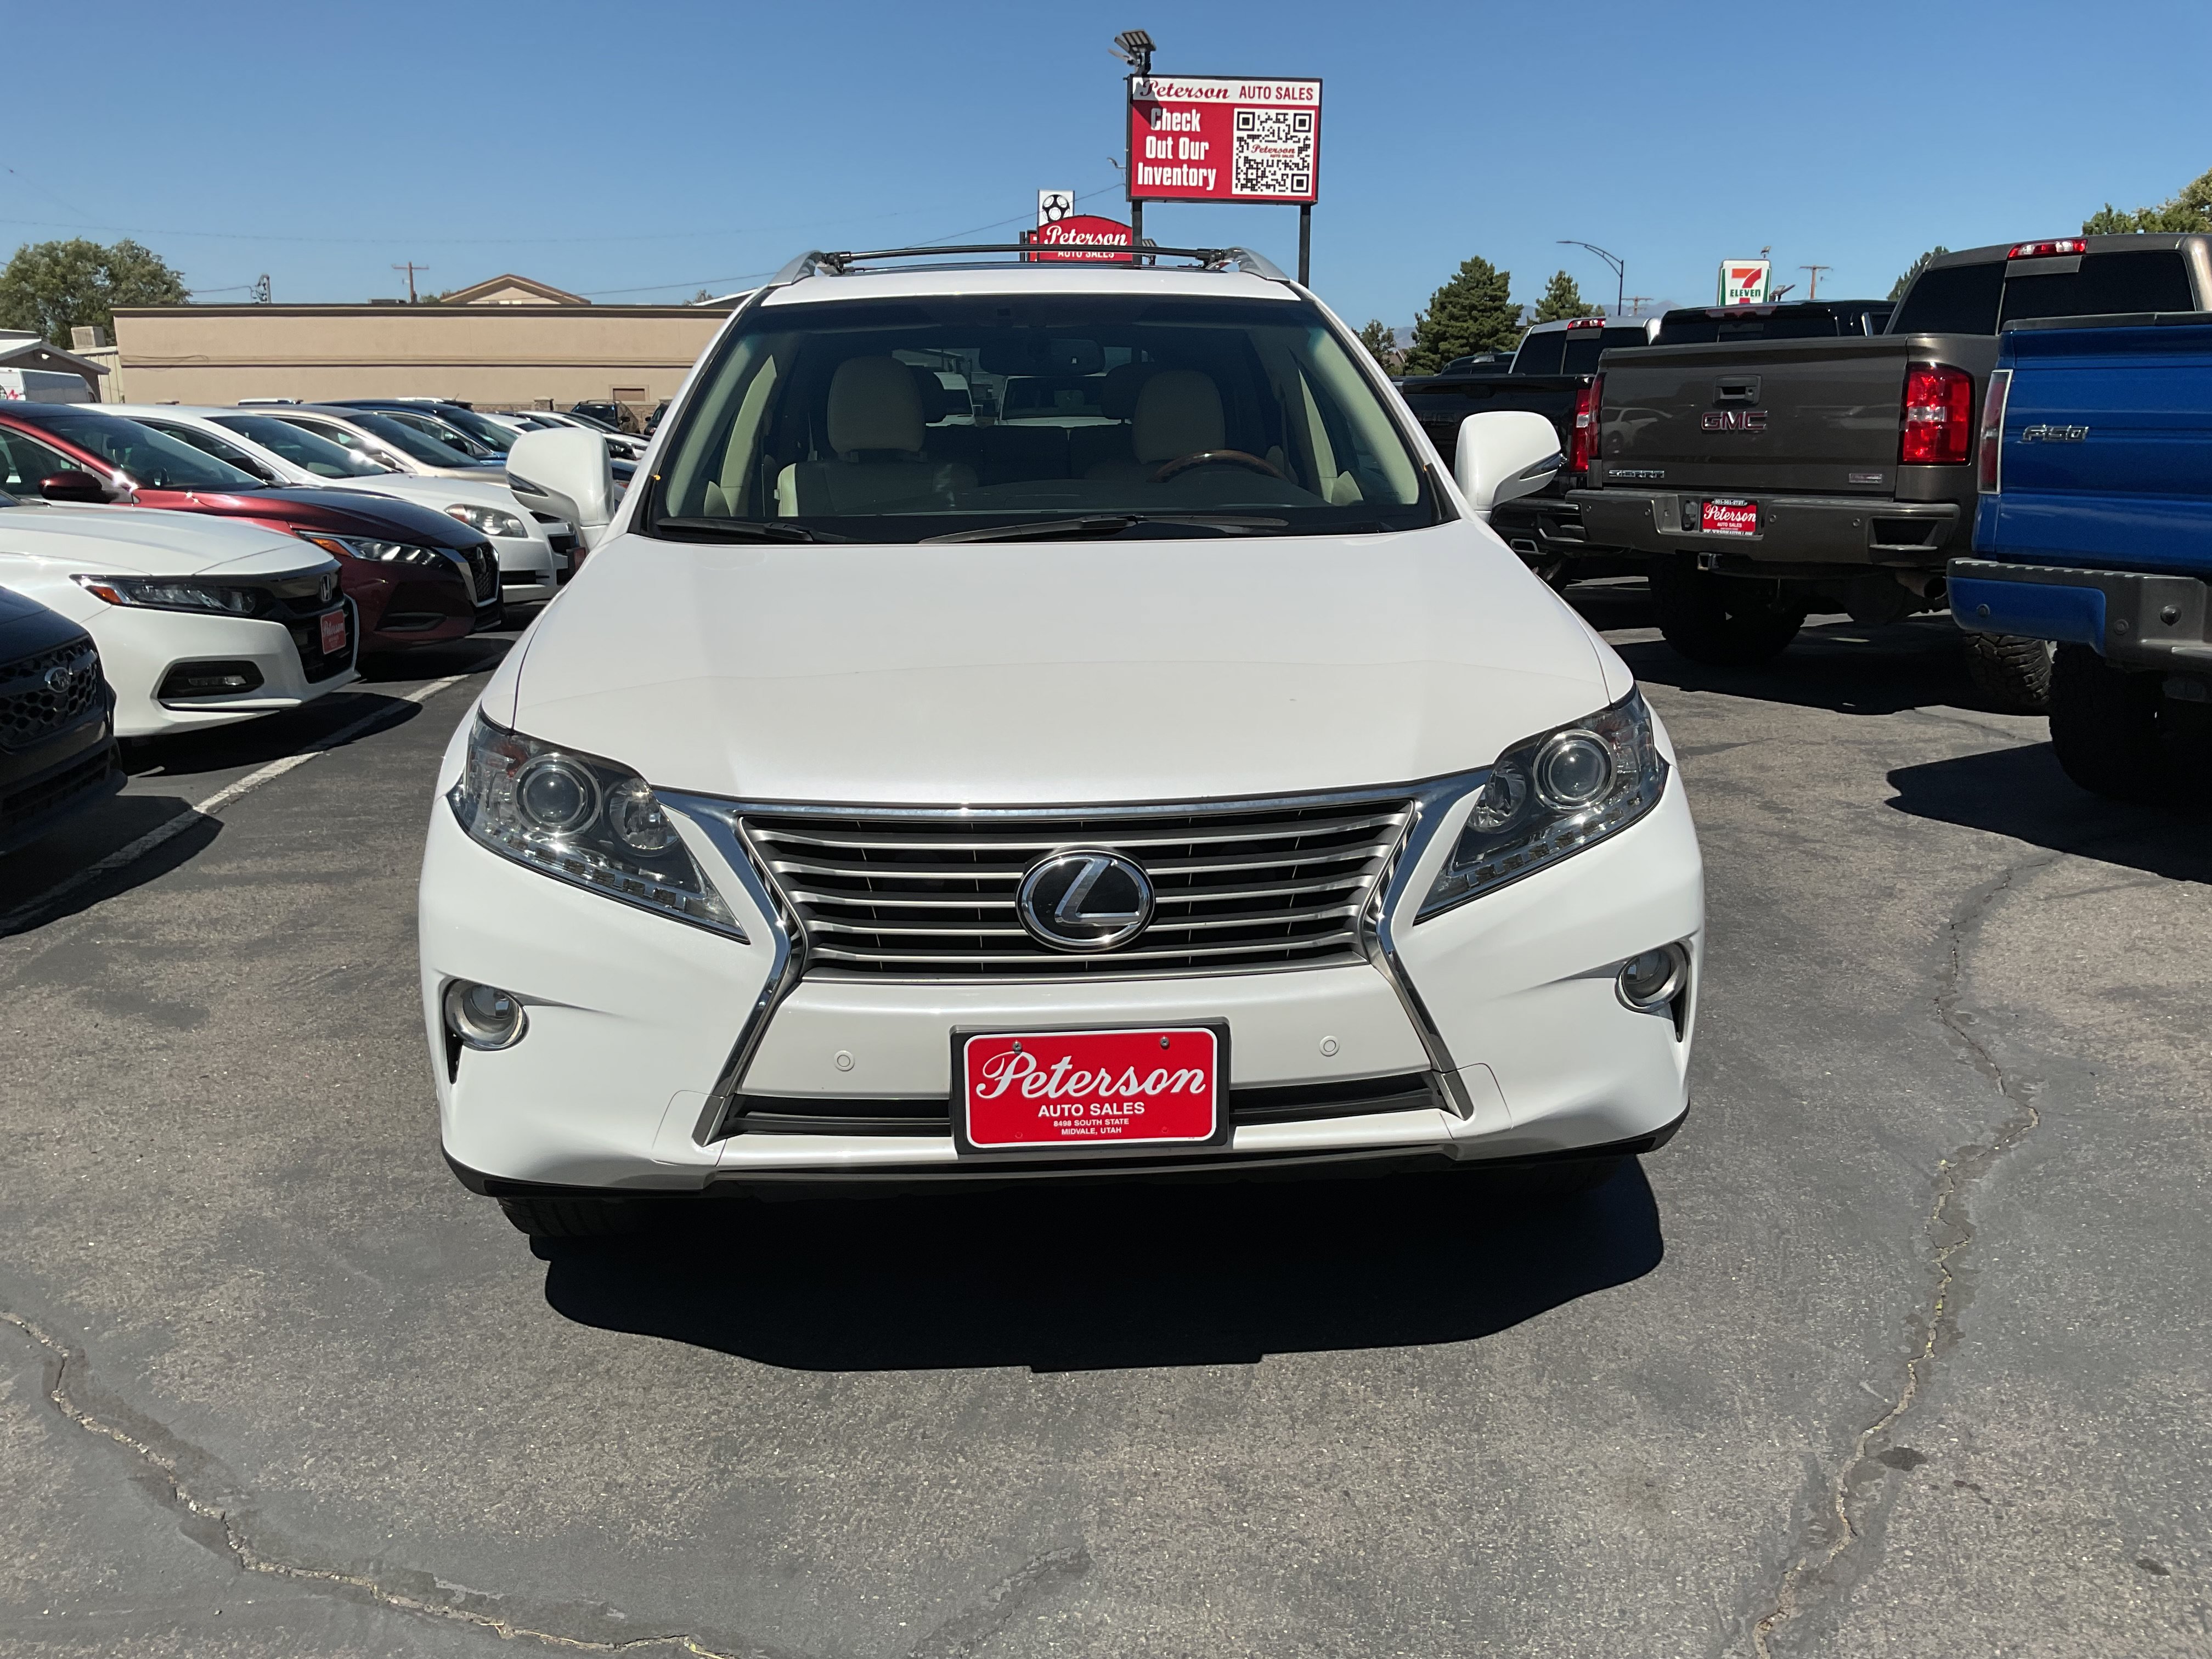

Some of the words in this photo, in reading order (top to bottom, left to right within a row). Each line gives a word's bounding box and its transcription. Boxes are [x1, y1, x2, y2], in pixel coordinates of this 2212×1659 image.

[1139, 80, 1229, 99] Peterson
[1239, 85, 1272, 100] AUTO
[1276, 86, 1313, 101] SALES
[1150, 108, 1201, 132] Check
[1146, 136, 1173, 159] Out
[1179, 137, 1210, 160] Our
[1251, 144, 1296, 154] Peterson
[1137, 162, 1217, 191] Inventory
[1044, 225, 1127, 246] Peterson
[1731, 267, 1762, 303] 7
[1701, 410, 1768, 430] GMC
[1703, 504, 1756, 522] Peterson
[976, 1051, 1206, 1099] Peterson
[1038, 1103, 1084, 1118] AUTO
[1090, 1102, 1145, 1115] SALES
